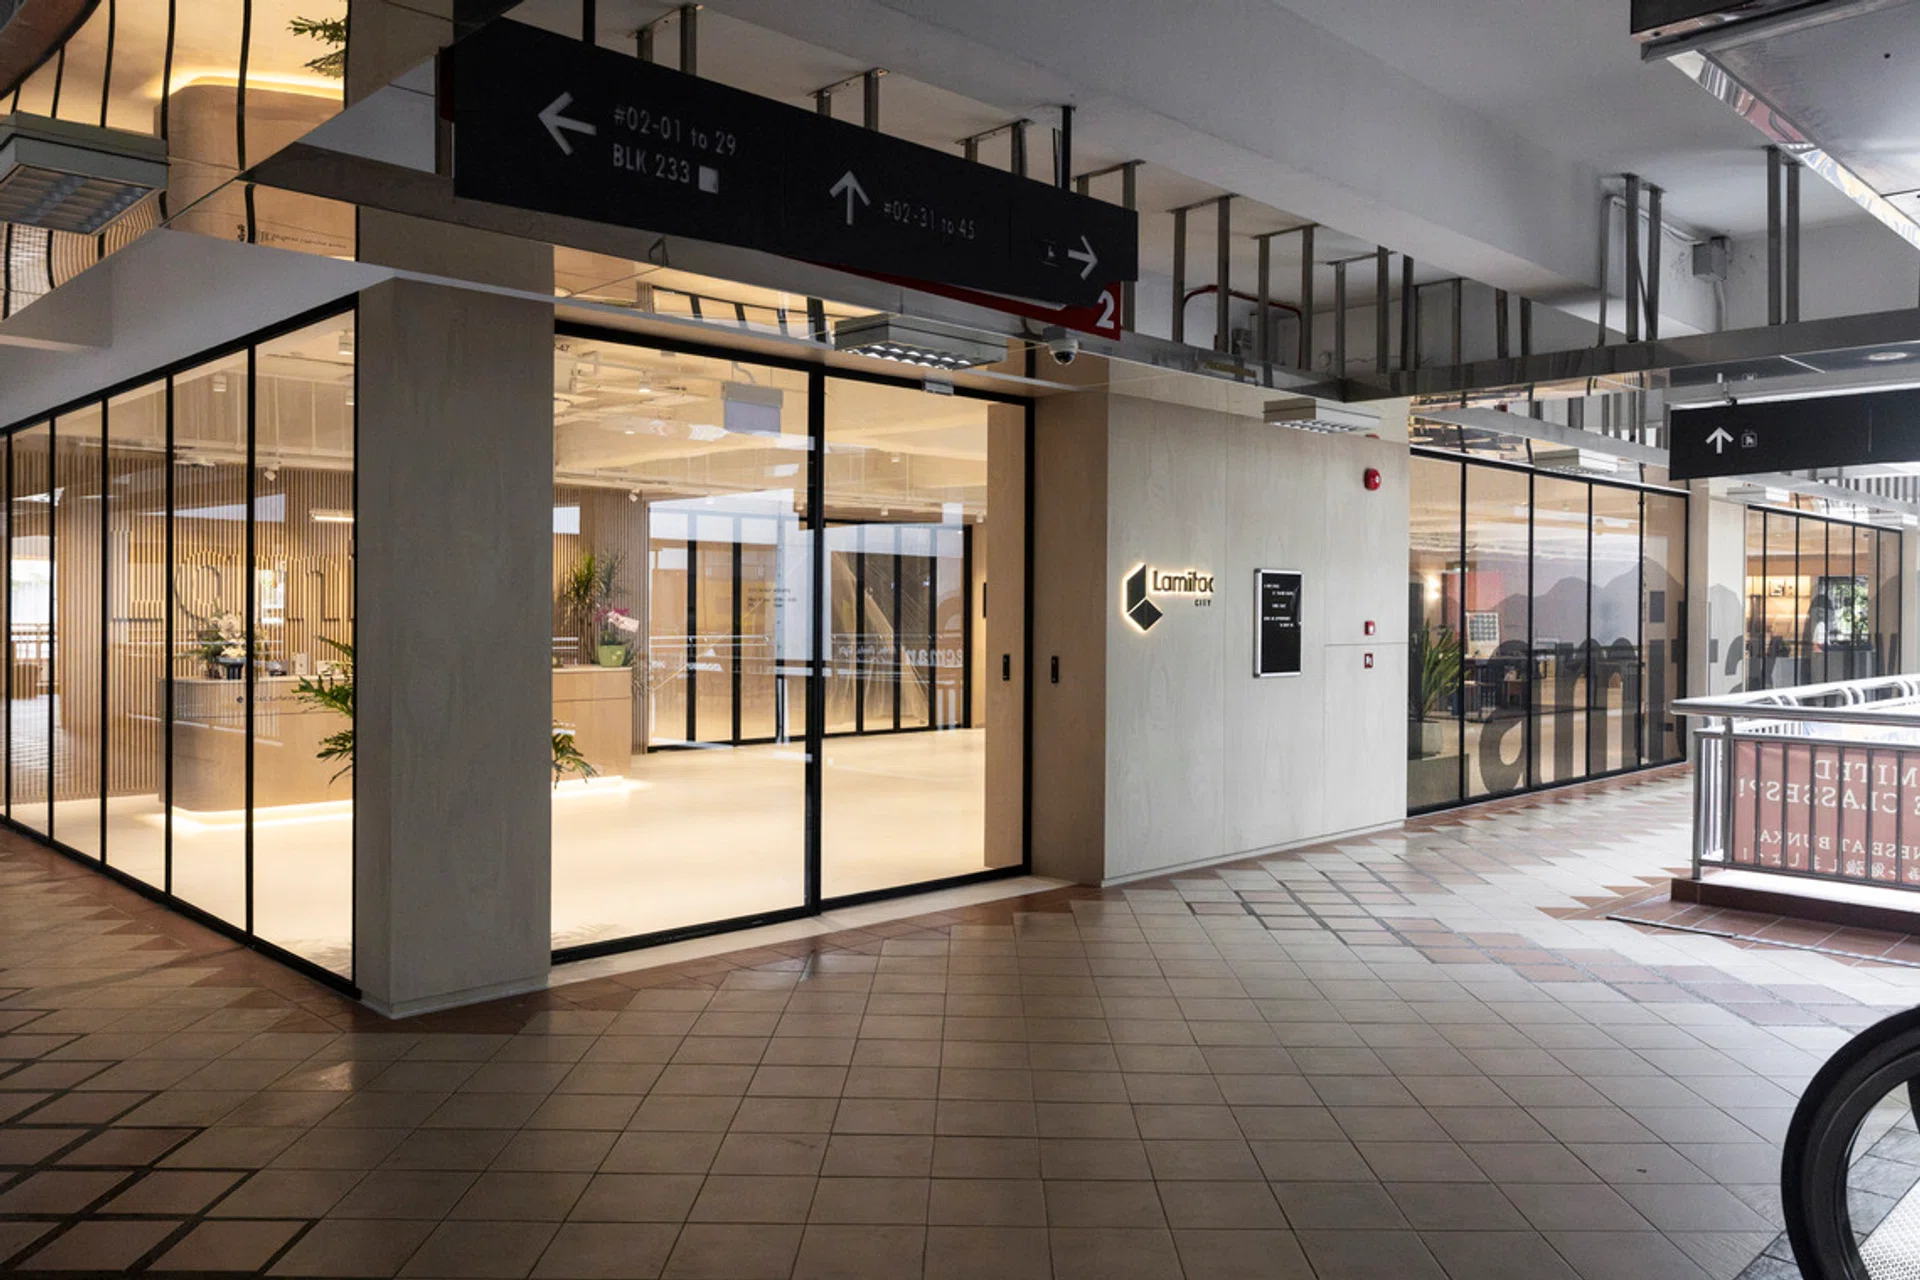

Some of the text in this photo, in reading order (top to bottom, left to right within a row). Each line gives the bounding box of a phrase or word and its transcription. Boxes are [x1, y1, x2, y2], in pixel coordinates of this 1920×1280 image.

[612, 103, 737, 157] #02-01 to 29
[612, 142, 690, 185] BLK 233
[941, 217, 955, 236] to
[959, 218, 976, 241] 45
